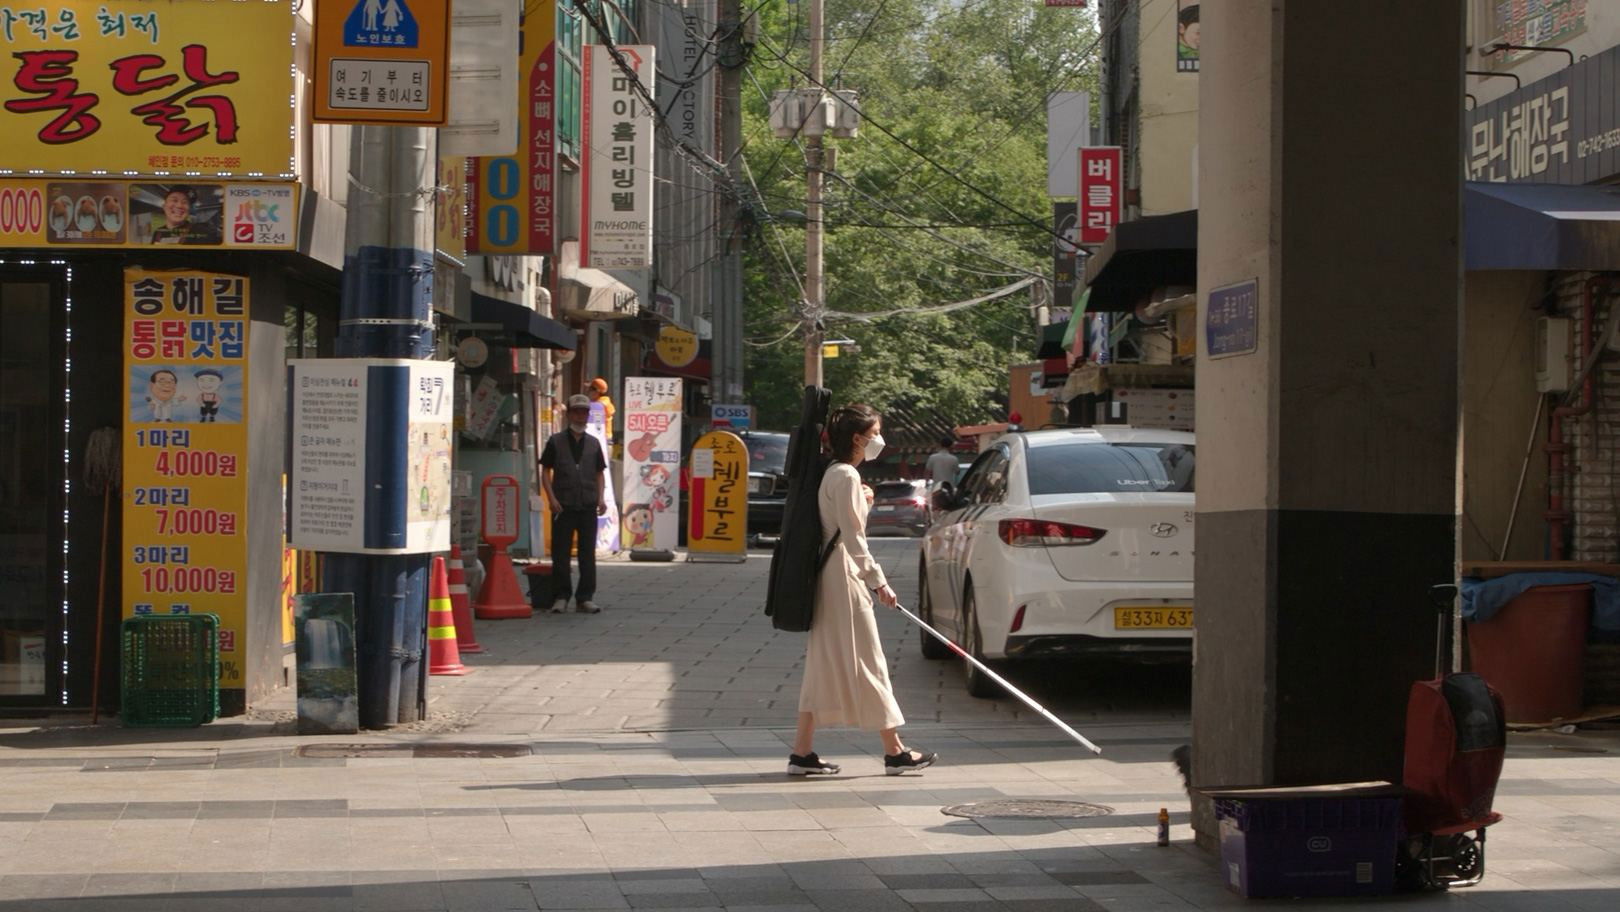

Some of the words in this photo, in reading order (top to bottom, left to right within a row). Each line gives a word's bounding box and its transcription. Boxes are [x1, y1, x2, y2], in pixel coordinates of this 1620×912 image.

[355, 33, 406, 45] 노인보호
[683, 15, 696, 62] HOTEL
[4, 43, 239, 146] 통닭
[335, 86, 370, 102] 속도를
[376, 87, 423, 103] 줄이시오
[1465, 86, 1569, 183] 문난해장국
[230, 189, 250, 197] KBS
[532, 129, 552, 236] 선지해장국
[234, 200, 279, 222] jtbc
[258, 224, 273, 232] TV
[258, 233, 285, 244] 조선
[134, 278, 244, 316] 송해길
[727, 408, 749, 418] SBS
[136, 430, 190, 448] 1마리
[710, 437, 737, 457] 종로
[156, 452, 237, 477] 4,000원
[134, 488, 190, 506] 2마리
[705, 460, 740, 541] 쉘부르
[156, 510, 236, 535] 7,000원
[134, 547, 189, 564] 3마리
[142, 568, 236, 594] 10,000원
